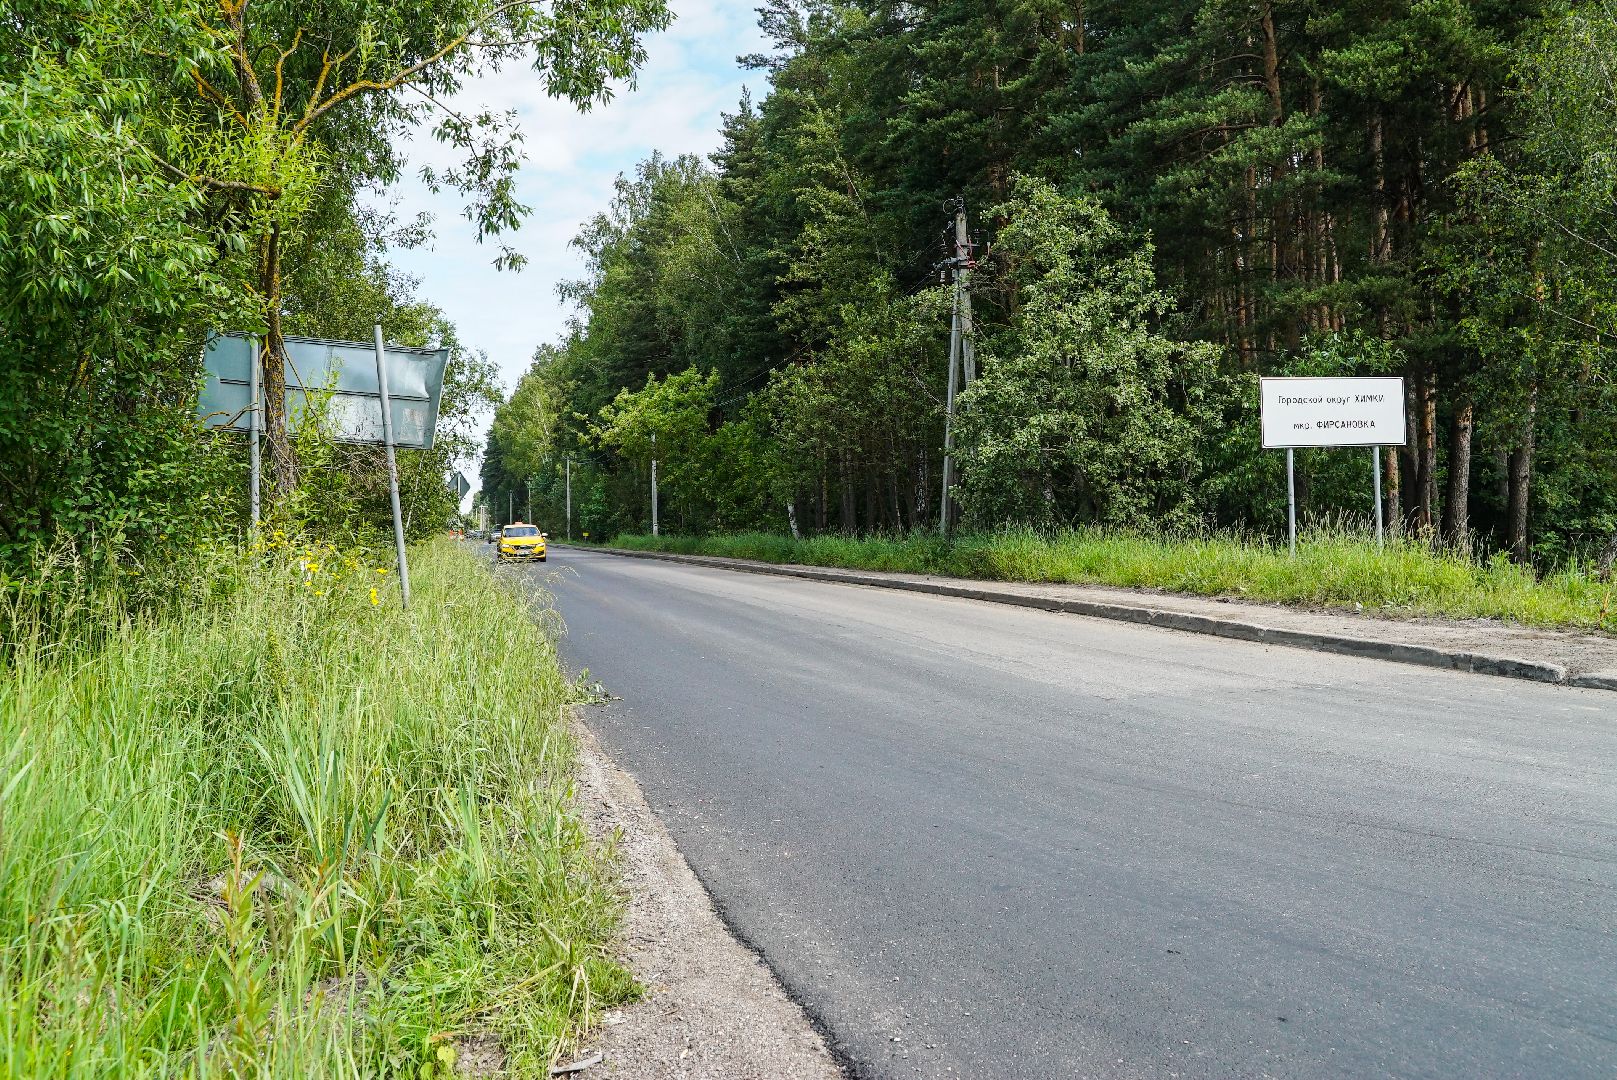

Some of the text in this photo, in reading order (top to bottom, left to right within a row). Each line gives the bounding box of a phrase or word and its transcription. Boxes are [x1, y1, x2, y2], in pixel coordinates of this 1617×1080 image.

[1278, 394, 1385, 405] Городской округ ХИМКИ
[1316, 420, 1376, 429] ФИРСАНОВКА
